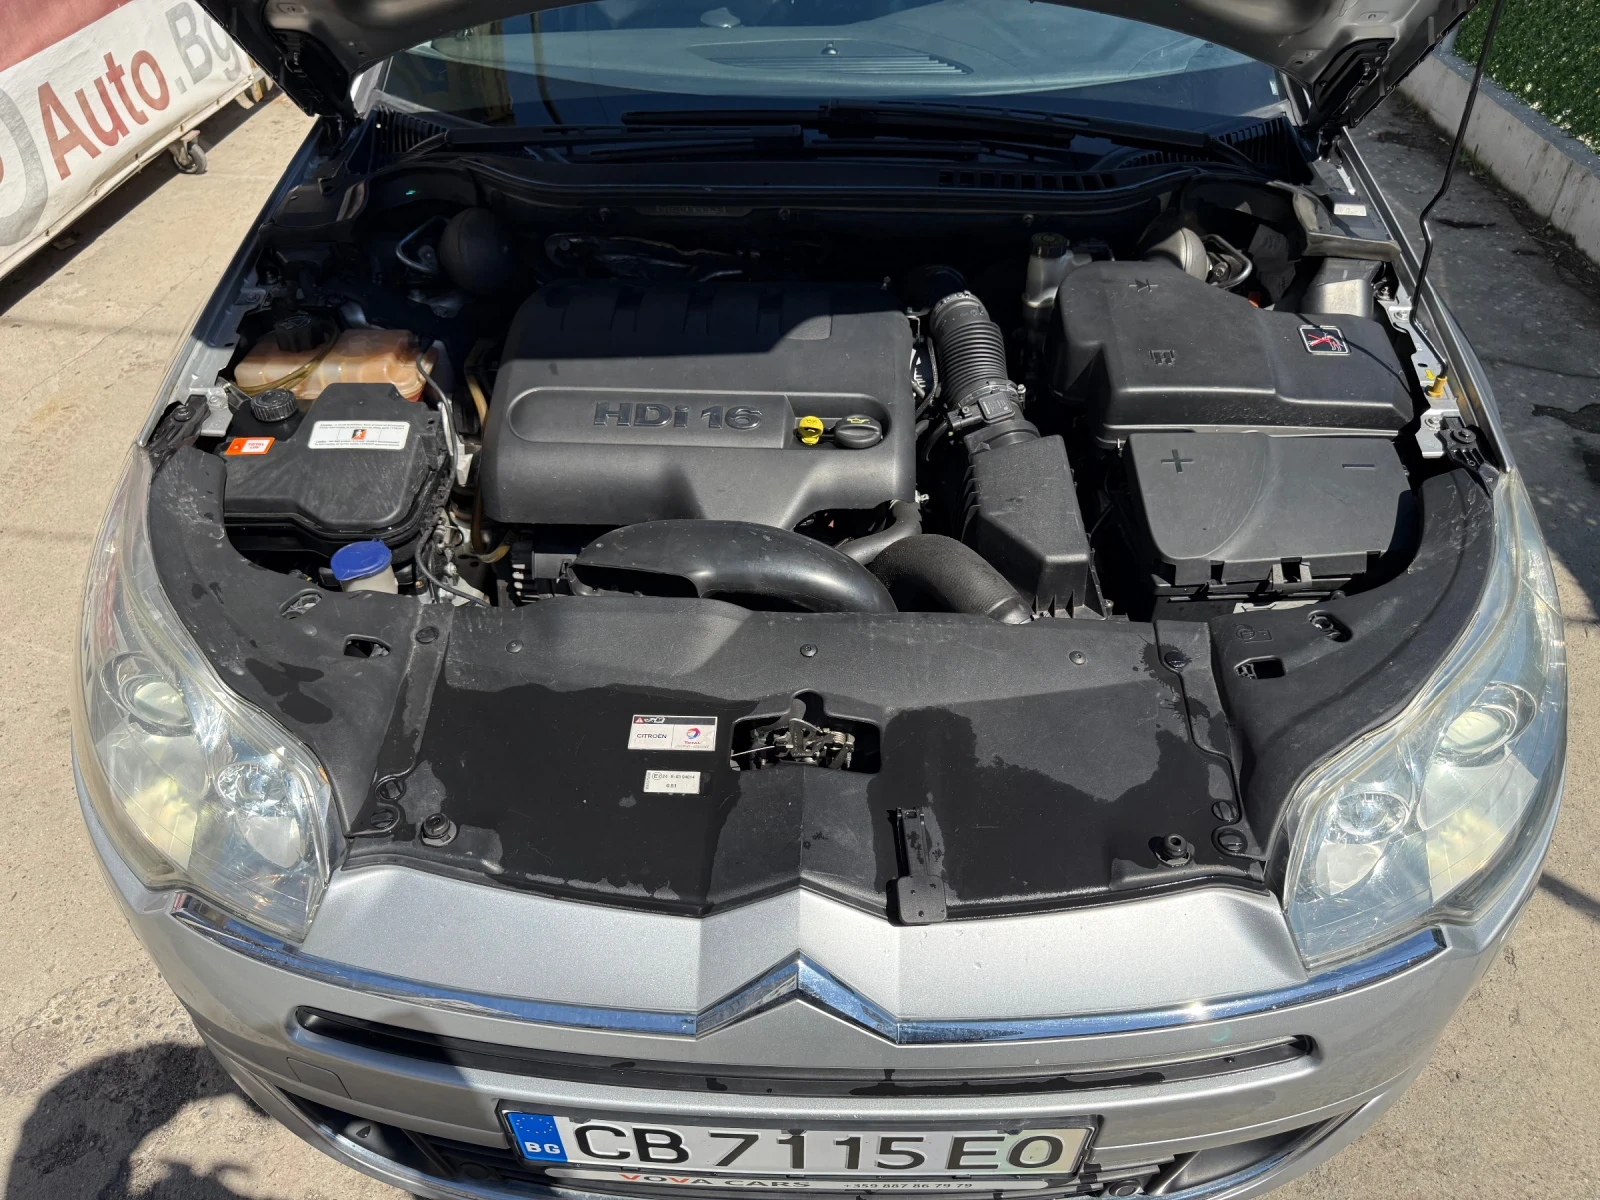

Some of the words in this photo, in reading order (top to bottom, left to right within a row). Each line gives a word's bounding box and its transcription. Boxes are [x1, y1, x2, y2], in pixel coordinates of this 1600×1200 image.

[593, 401, 691, 429] HDi
[700, 405, 763, 430] 16
[524, 1141, 561, 1155] BG
[574, 1124, 690, 1164] CB
[708, 1131, 927, 1170] 7115
[619, 1173, 713, 1185] VOVA
[725, 1180, 811, 1188] CARS
